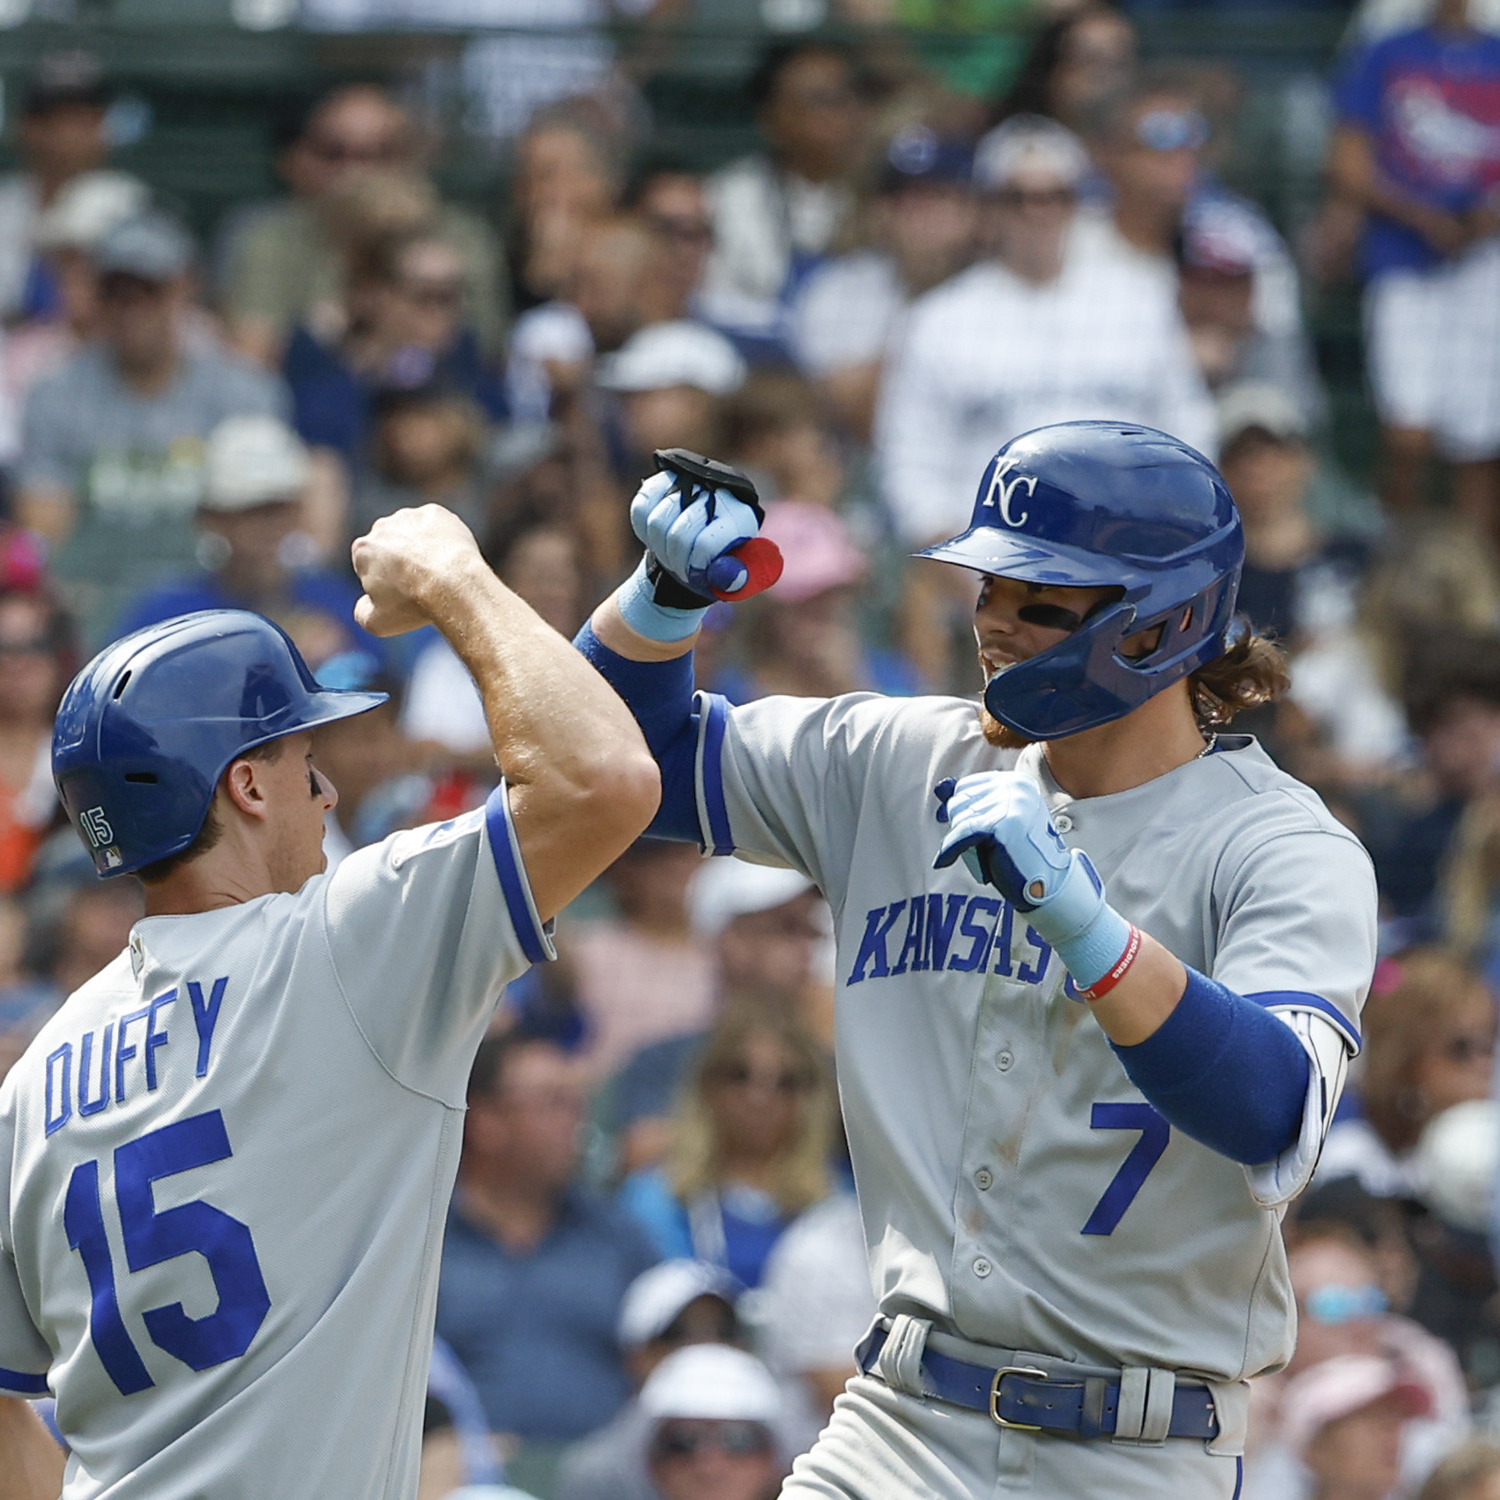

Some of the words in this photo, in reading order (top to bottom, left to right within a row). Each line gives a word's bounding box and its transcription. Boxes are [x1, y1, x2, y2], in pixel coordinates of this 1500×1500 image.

[983, 456, 1037, 527] KC
[80, 806, 113, 848] 15
[846, 893, 1052, 987] KANSAS
[1111, 938, 1139, 979] SOLDIERS
[45, 976, 229, 1138] DUFFY
[1080, 1103, 1170, 1236] 7
[64, 1108, 271, 1396] 15
